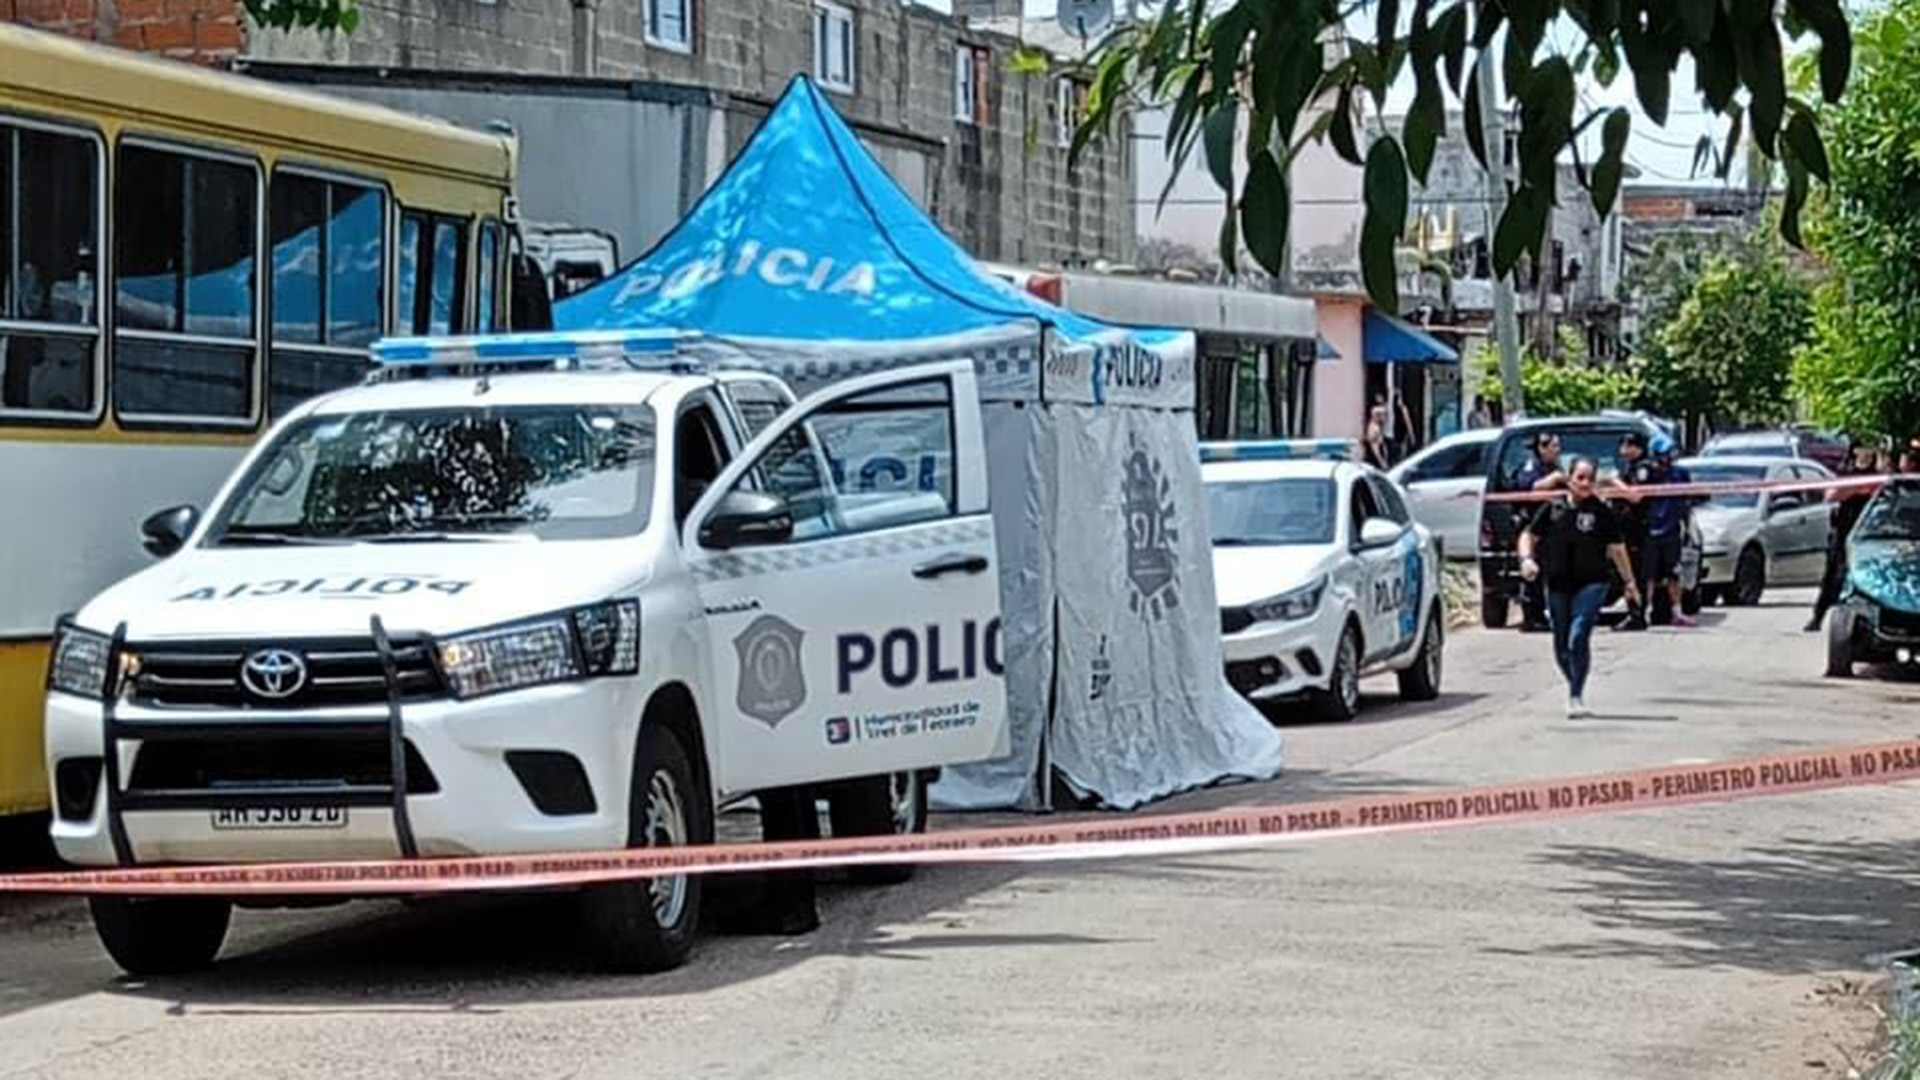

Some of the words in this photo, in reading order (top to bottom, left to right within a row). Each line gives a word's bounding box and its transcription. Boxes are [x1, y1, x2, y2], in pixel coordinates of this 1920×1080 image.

[1259, 815, 1283, 833] NO
[1287, 810, 1342, 832] PASAR
[1358, 798, 1458, 827] PERIMETRO
[1463, 790, 1539, 818] POLICIAL
[1548, 786, 1574, 808] NO
[1578, 779, 1634, 806] PASAR
[1652, 766, 1755, 798] PERIMETRO
[1759, 757, 1842, 787] POLICIAL
[1850, 753, 1877, 777] NO
